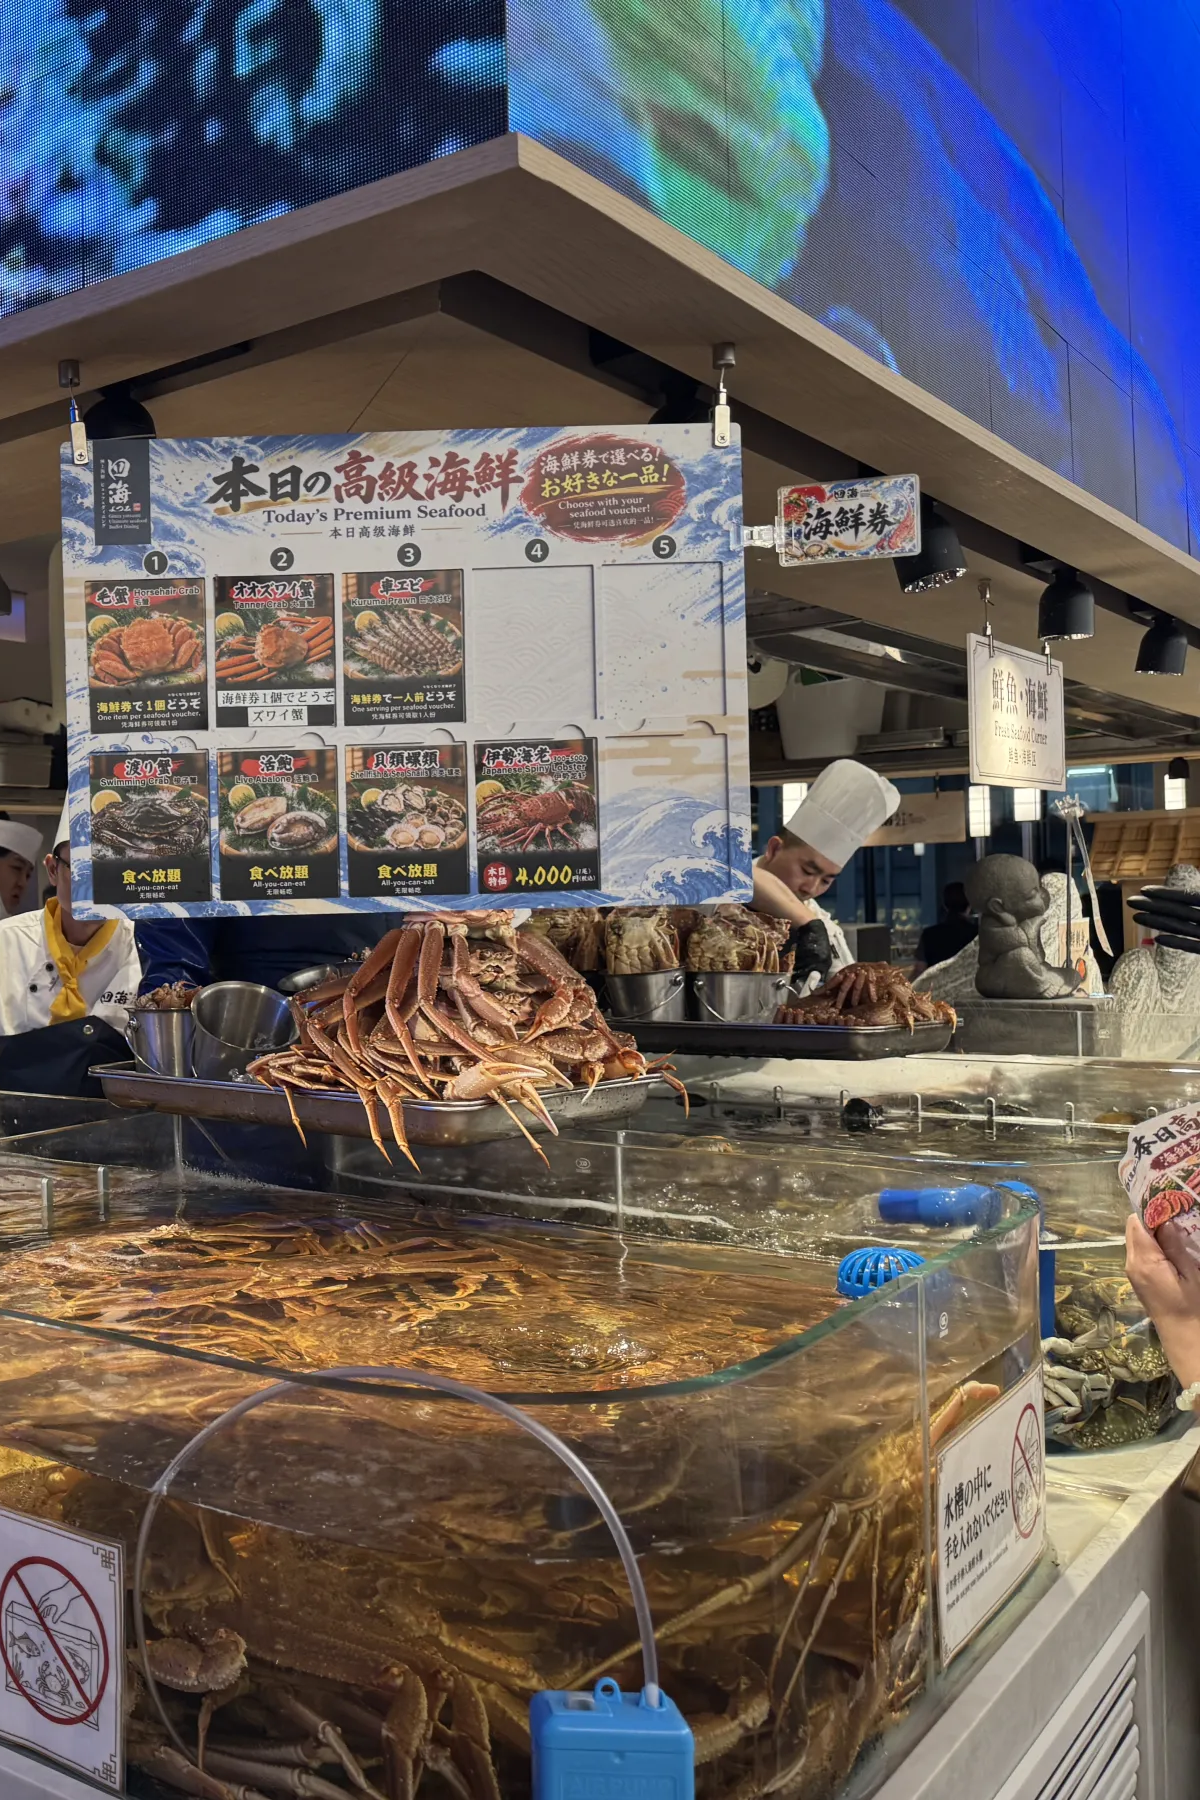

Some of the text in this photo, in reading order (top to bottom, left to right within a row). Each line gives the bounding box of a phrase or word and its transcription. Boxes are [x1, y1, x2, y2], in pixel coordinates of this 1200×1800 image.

[540, 448, 661, 475] 海鮮券で選べる!
[205, 448, 526, 512] 本日の高級海鮮
[540, 464, 669, 498] お好きな一品!
[558, 497, 644, 510] Choose with your
[263, 503, 487, 526] Today's Premium Seafood
[569, 504, 650, 519] seafood voucher!
[803, 502, 897, 542] 海鮮券
[404, 548, 415, 562] 3
[530, 543, 543, 558] 4
[658, 540, 670, 555] 5
[150, 556, 159, 571] 1
[276, 552, 287, 567] 2
[134, 586, 201, 598] Horsehair Crab
[233, 580, 315, 600] オオズワイ蟹
[380, 577, 424, 596] 車エビ
[96, 586, 130, 607] 毛蟹
[351, 596, 416, 607] Kuruma Prawn
[234, 599, 288, 610] Tanner Crab
[222, 690, 334, 705] 海鮮券1個でどうぞ
[350, 690, 456, 705] 海鮮券で一人前どうぞ
[992, 667, 1049, 724] 鮮魚・海鮮
[96, 699, 201, 714] 海鮮券で1個どうぞ
[352, 702, 456, 714] One serving per seafood voucher.
[97, 710, 201, 722] One item per seafood voucher.
[252, 708, 304, 723] ズワイ蟹
[1010, 723, 1031, 743] Seafood
[1031, 727, 1048, 745] Corner
[259, 754, 294, 774] 活鮑
[373, 750, 440, 769] 貝類螺類
[485, 746, 551, 767] 伊勢海老
[124, 757, 173, 777] 渡り蟹
[350, 768, 429, 779] Shellfish & Sea Snails
[482, 762, 586, 776] Japanese Spiny Lobster
[100, 776, 170, 787] Swimming Crab
[235, 774, 291, 785] Live Abalone
[122, 869, 182, 884] 食べ放題
[249, 865, 309, 880] 食べ放題
[377, 864, 438, 879] 食べ放題
[488, 867, 506, 877] 本日
[515, 865, 572, 887] 4,000
[126, 884, 178, 892] All-you-can-eat
[253, 880, 306, 888] All-you-can-eat
[381, 879, 435, 887] All-you-can-eat
[487, 876, 508, 887] 特価
[943, 1463, 993, 1531] 水槽の中に
[944, 1488, 1011, 1569] 手を入れないでください
